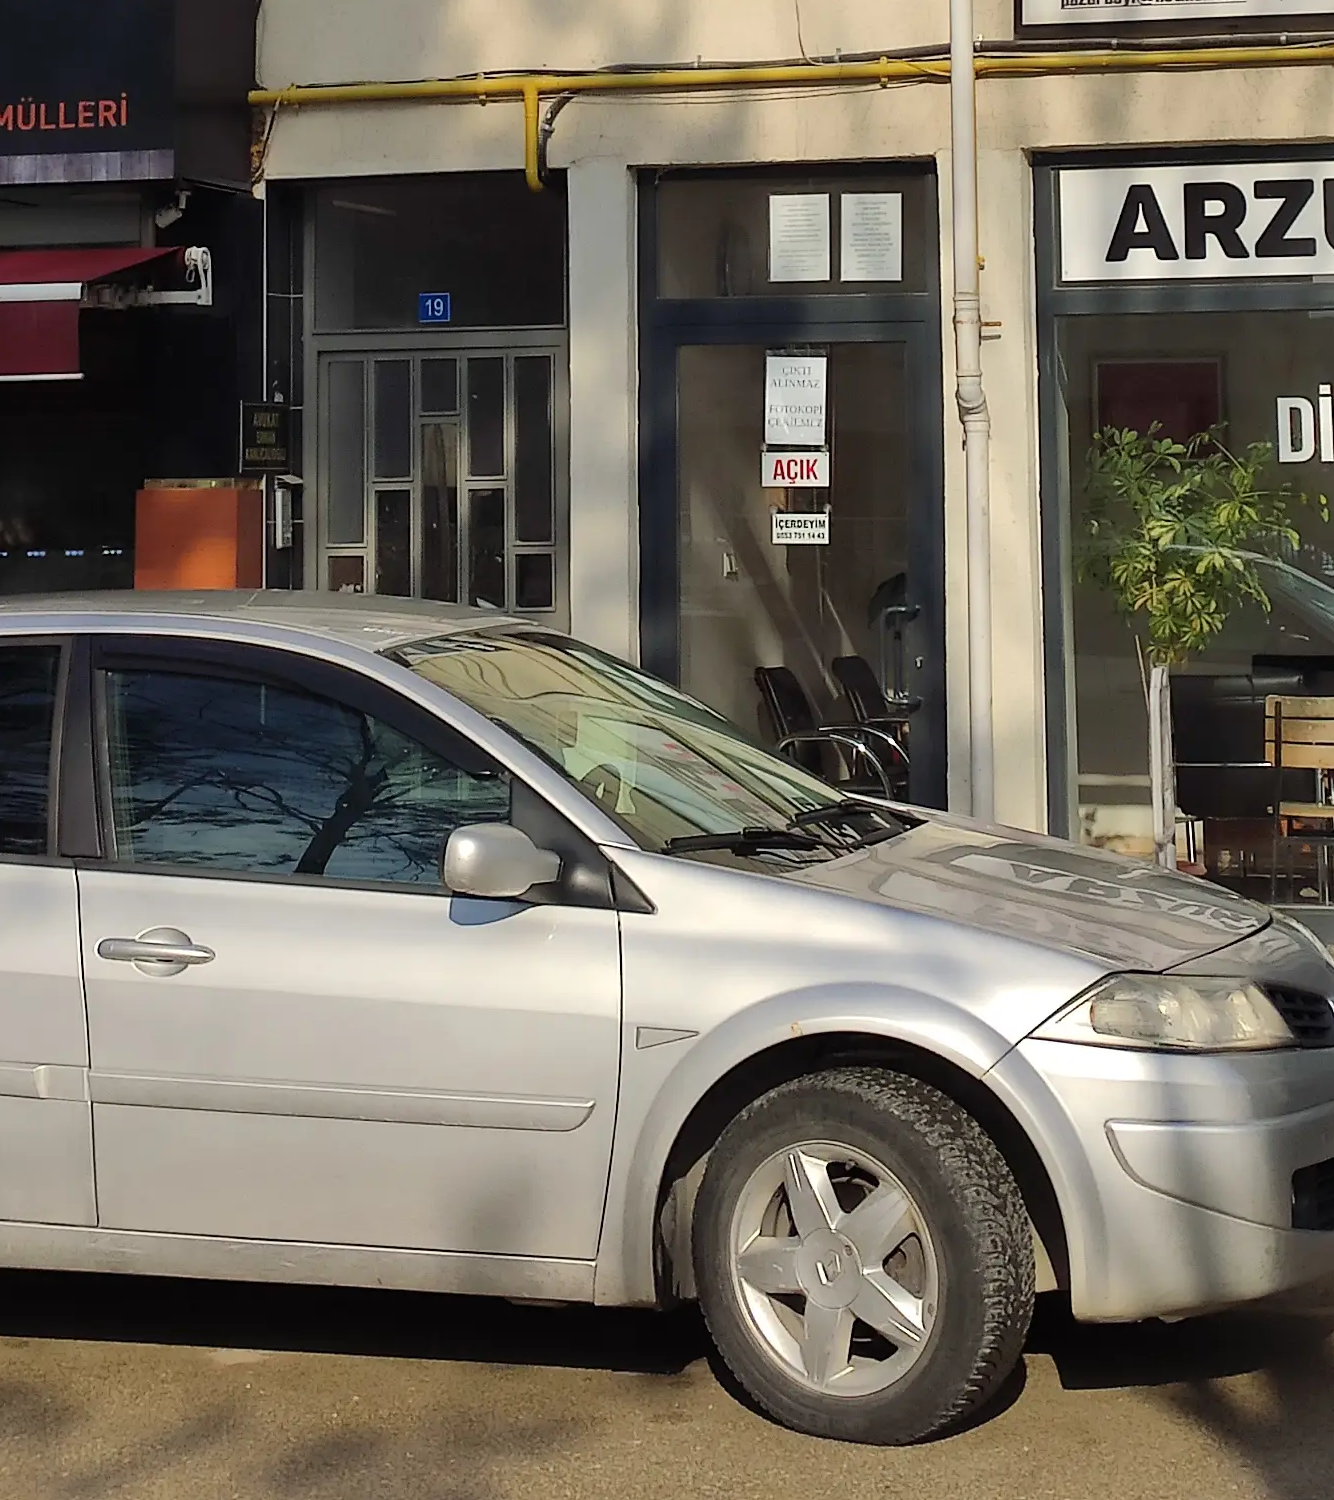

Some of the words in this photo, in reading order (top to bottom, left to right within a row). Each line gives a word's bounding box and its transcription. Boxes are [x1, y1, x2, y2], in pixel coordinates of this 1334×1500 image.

[425, 298, 444, 316] 19
[770, 377, 821, 389] ALINMAZ
[773, 459, 819, 484] AÇIK
